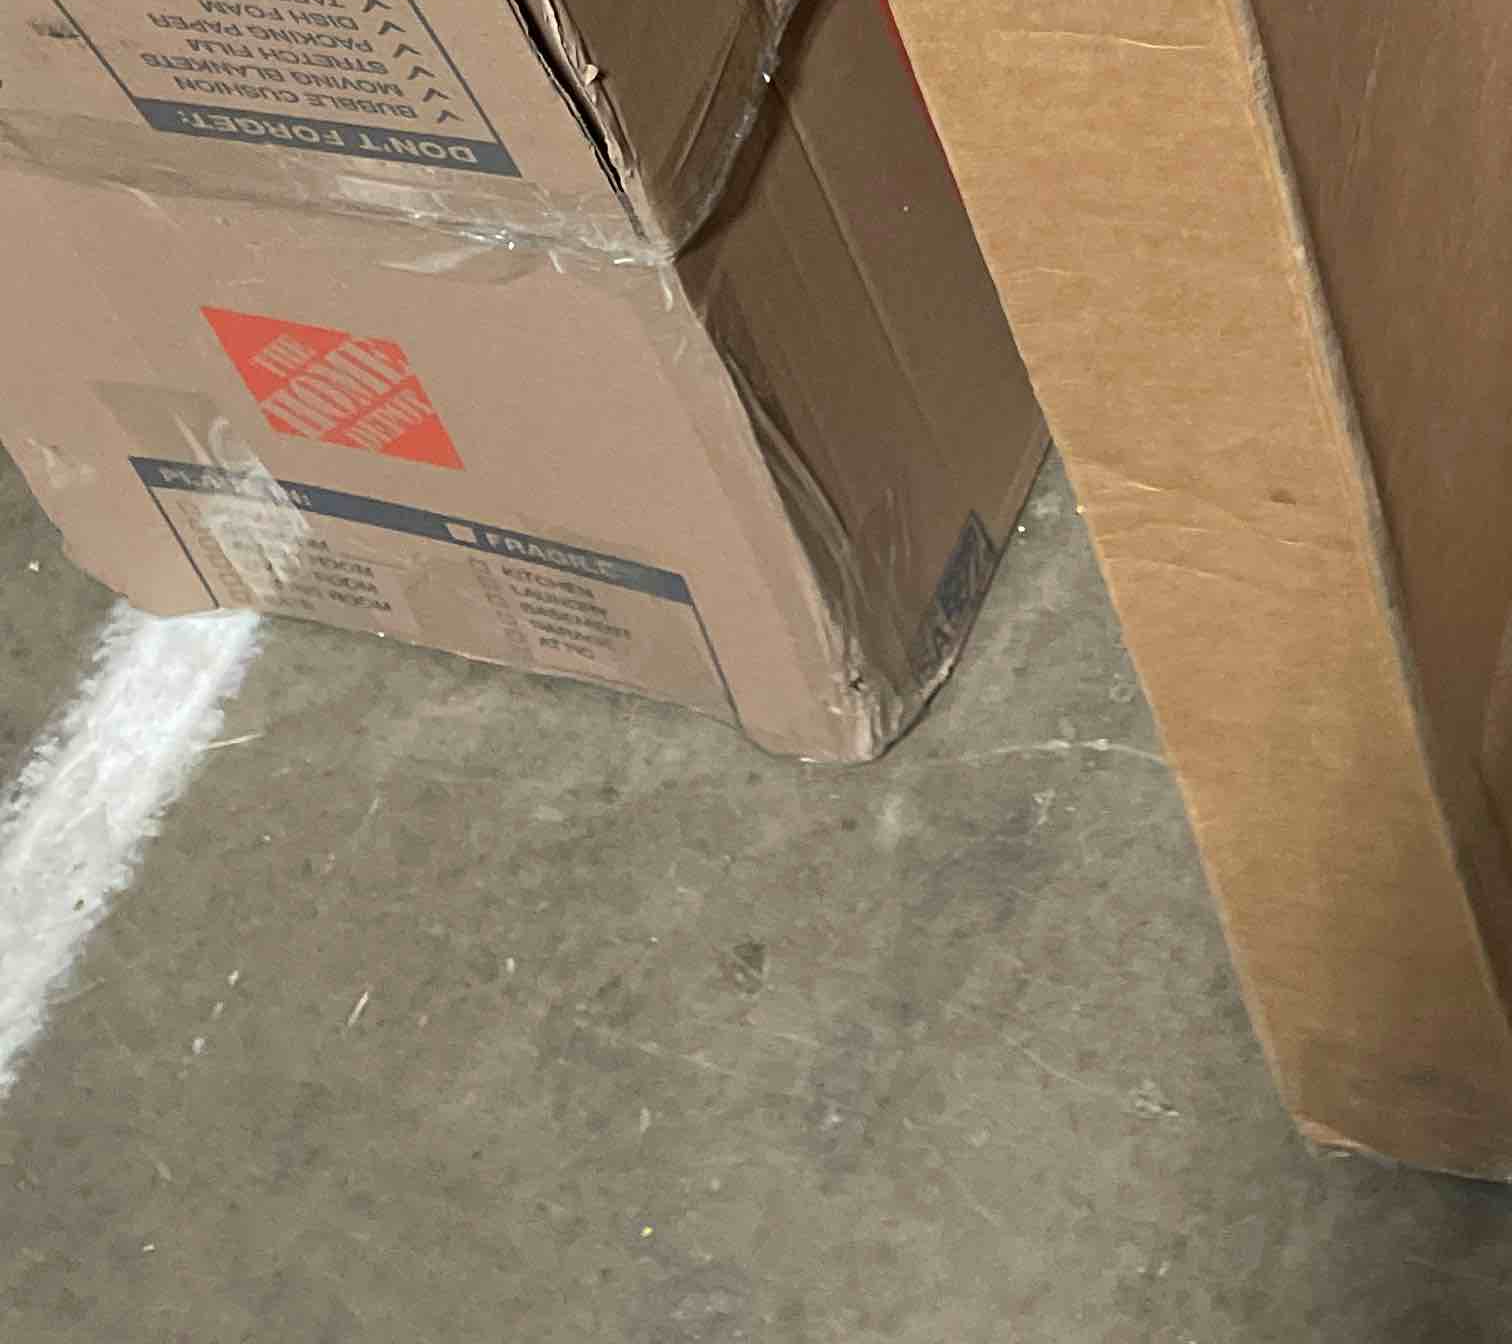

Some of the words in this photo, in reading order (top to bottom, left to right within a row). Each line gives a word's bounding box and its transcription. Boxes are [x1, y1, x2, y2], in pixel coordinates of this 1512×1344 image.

[148, 11, 243, 38] PAPER
[289, 8, 359, 32] DISH
[185, 37, 251, 60] FILM
[247, 23, 376, 54] PACKING
[139, 51, 285, 83] BLANKETS
[257, 46, 391, 75] STRETCH
[173, 74, 300, 104] CUSHION
[289, 69, 405, 98] MOVING
[308, 93, 418, 120] BUBBLE
[176, 109, 345, 147] FORGET:
[358, 133, 479, 164] DON'T
[258, 340, 412, 443] HOME
[341, 387, 438, 453] DEPOT
[485, 531, 613, 581] FRAGILE
